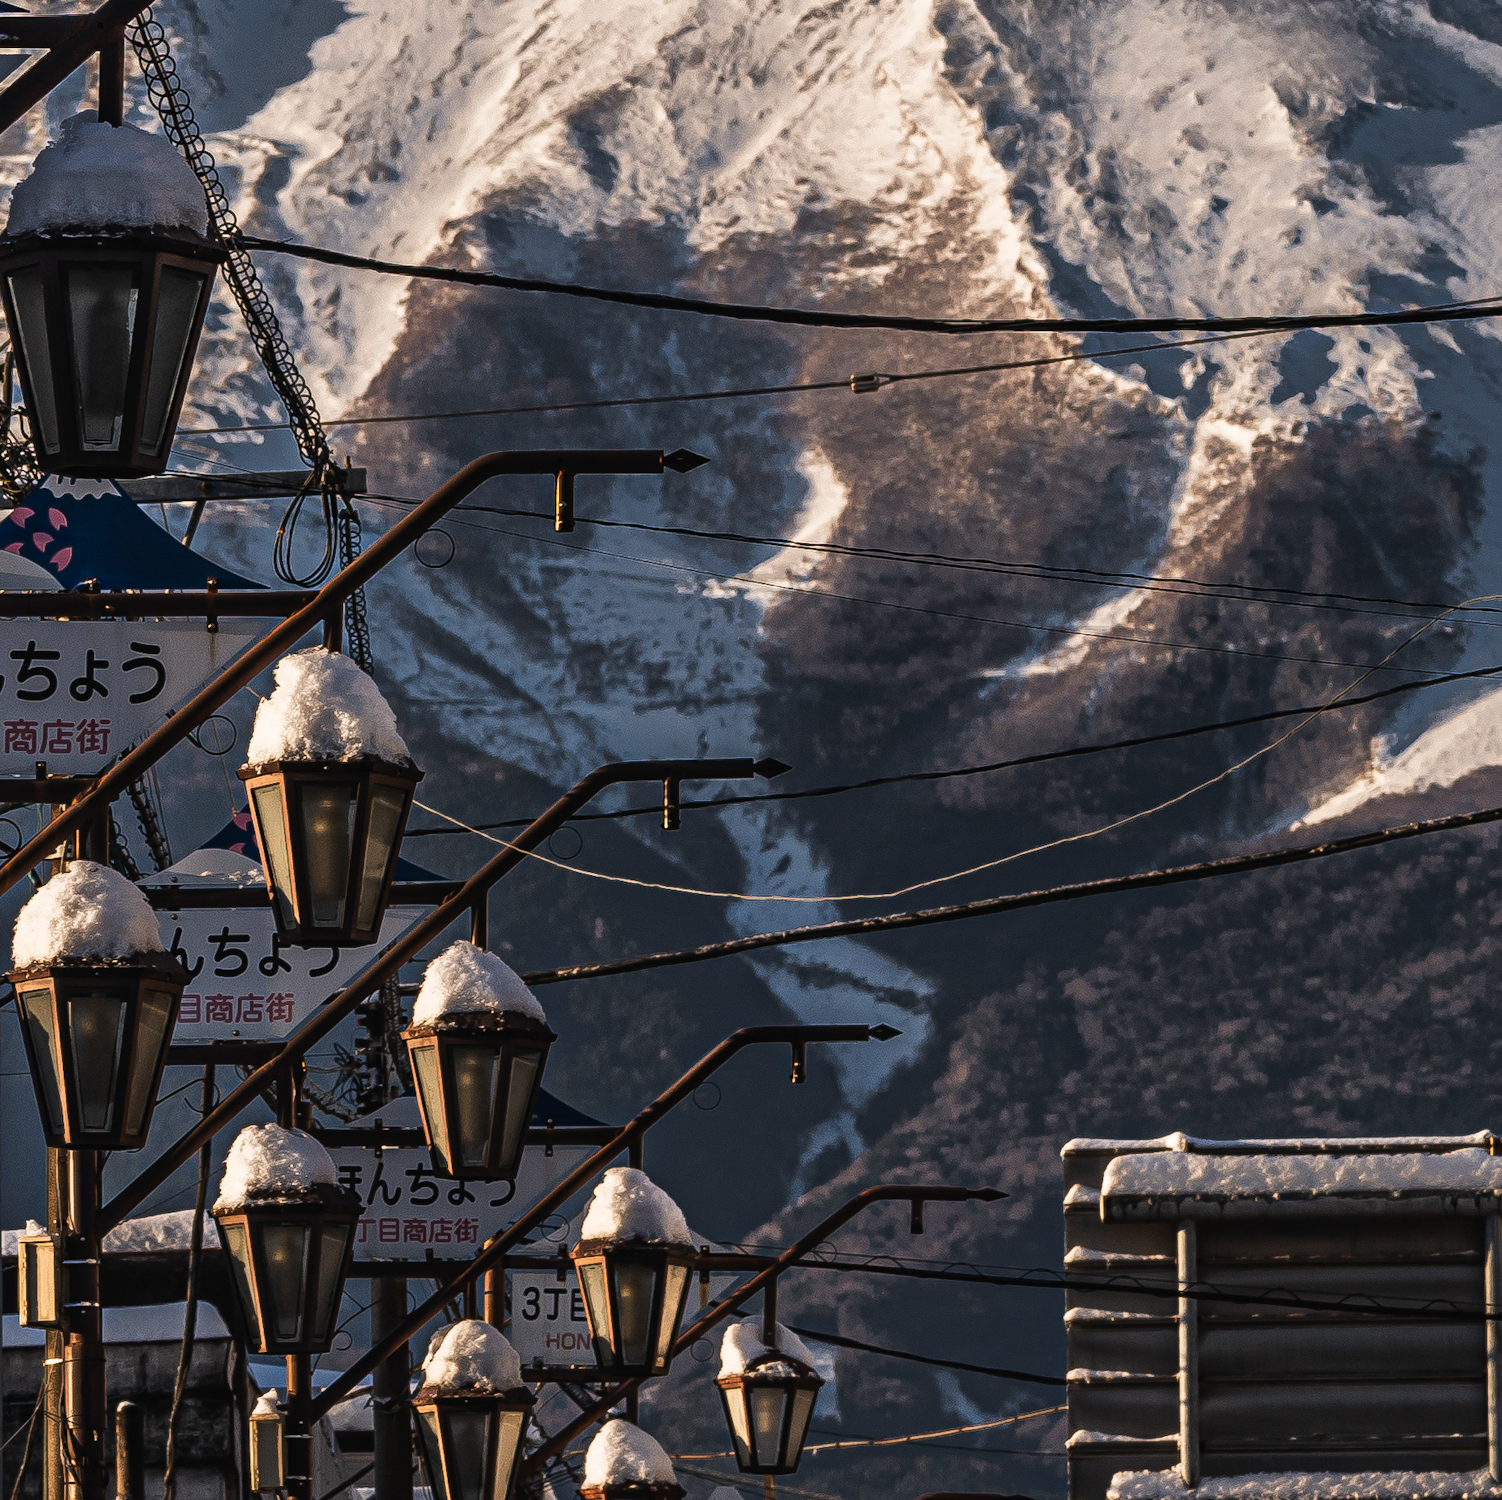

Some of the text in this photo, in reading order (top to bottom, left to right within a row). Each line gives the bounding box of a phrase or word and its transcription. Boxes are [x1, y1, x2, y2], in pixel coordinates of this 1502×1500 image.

[170, 926, 340, 978] んちょう
[177, 993, 296, 1024] 目商店街
[357, 1218, 479, 1243] 丁目商店街
